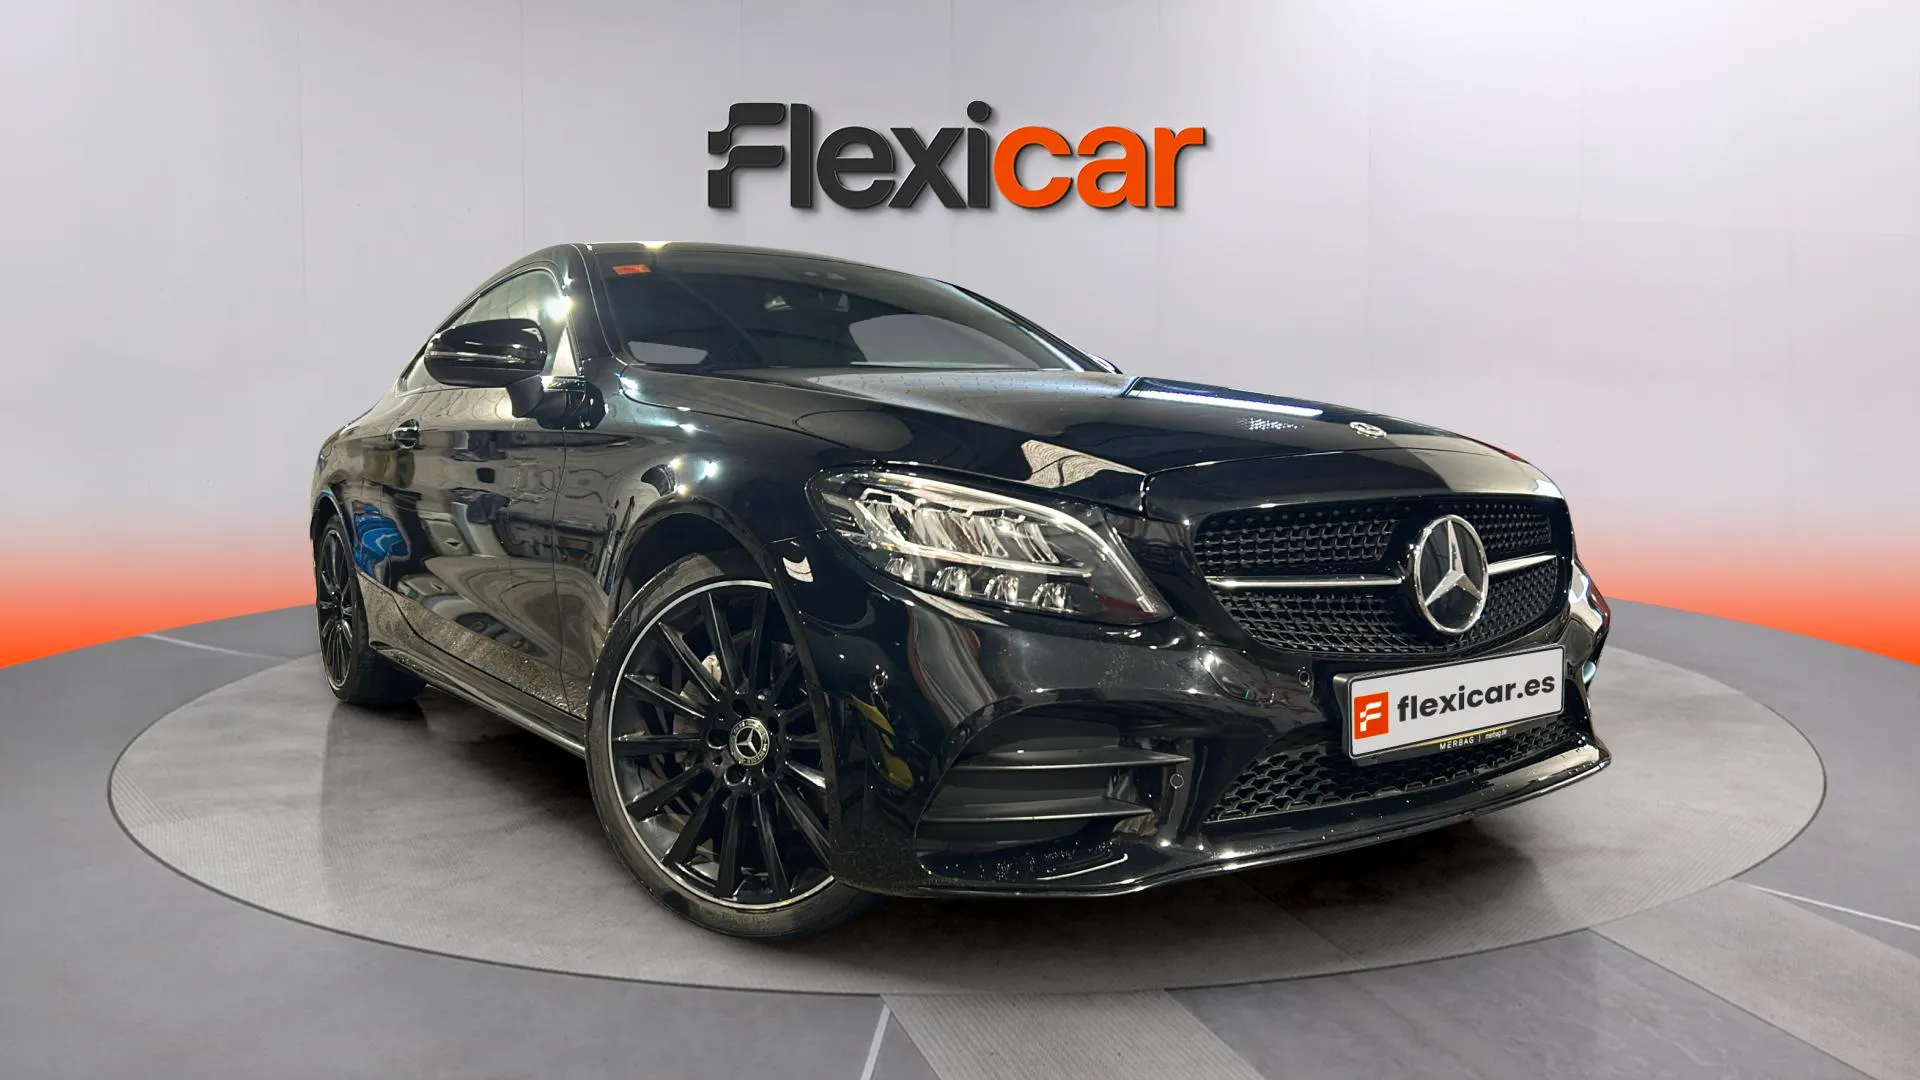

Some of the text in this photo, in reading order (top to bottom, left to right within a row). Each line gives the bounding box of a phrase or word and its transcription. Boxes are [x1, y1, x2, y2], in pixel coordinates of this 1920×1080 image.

[708, 101, 1205, 208] Flexicar
[1397, 675, 1555, 722] flexicar.es
[1439, 737, 1474, 750] MERBAG
